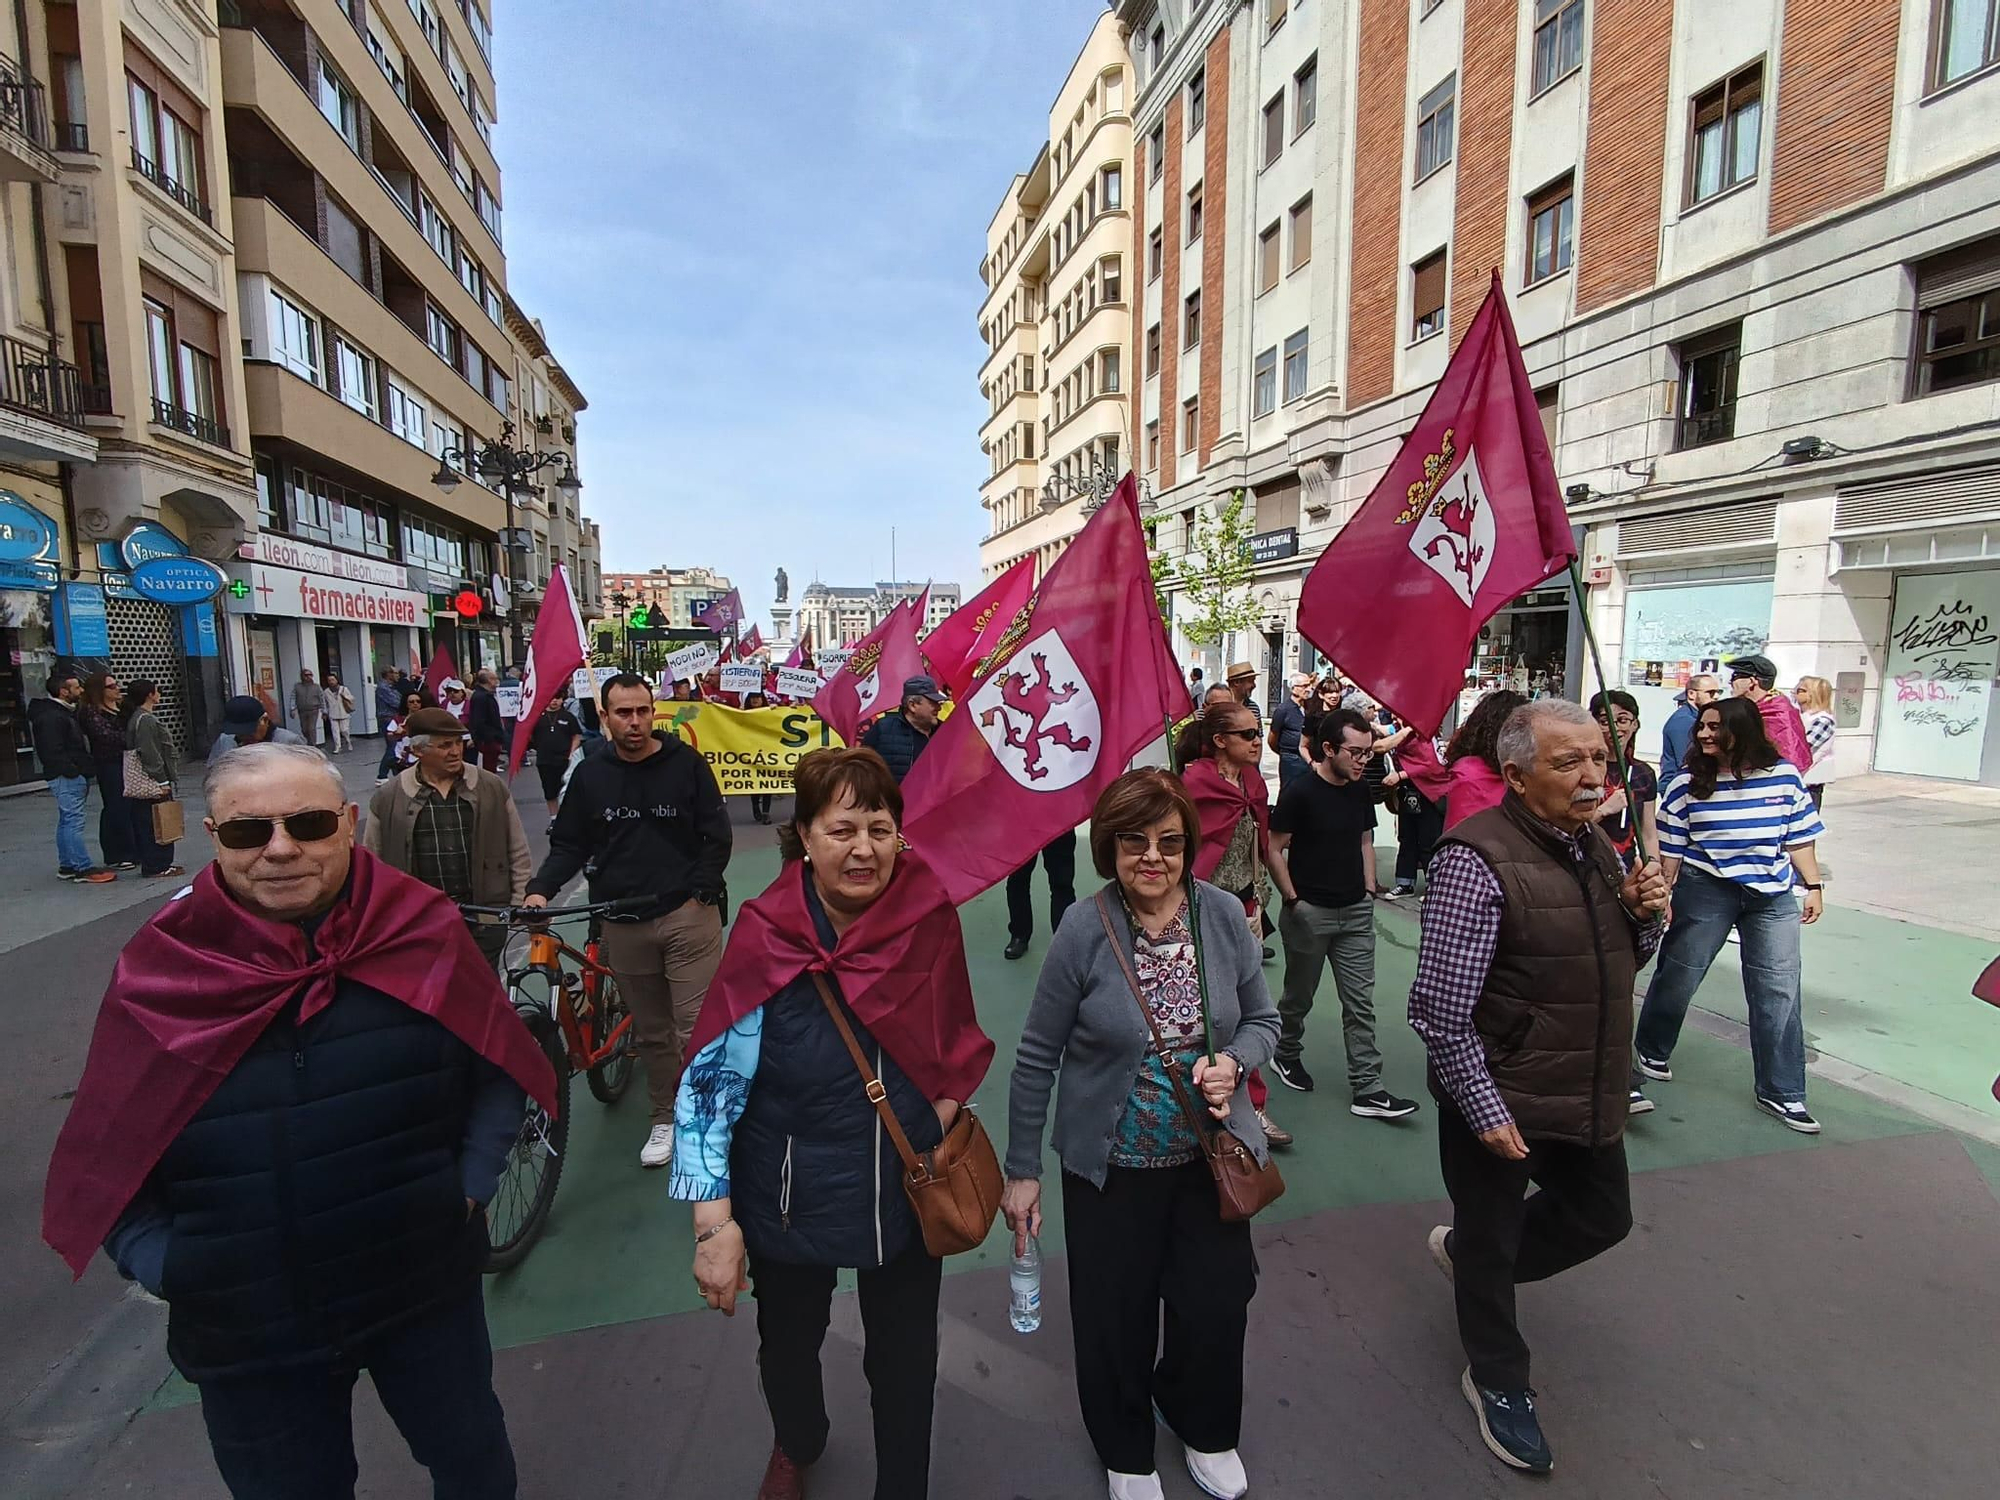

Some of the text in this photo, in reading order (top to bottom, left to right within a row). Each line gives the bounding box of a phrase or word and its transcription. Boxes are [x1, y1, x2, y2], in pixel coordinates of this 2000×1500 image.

[166, 568, 210, 577] OPTICA
[140, 576, 215, 591] Navarro
[300, 576, 415, 623] farmacia sirera
[669, 647, 706, 669] MODINO
[704, 749, 778, 765] BIOGÁS
[721, 769, 751, 778] POR
[724, 780, 754, 790] POR
